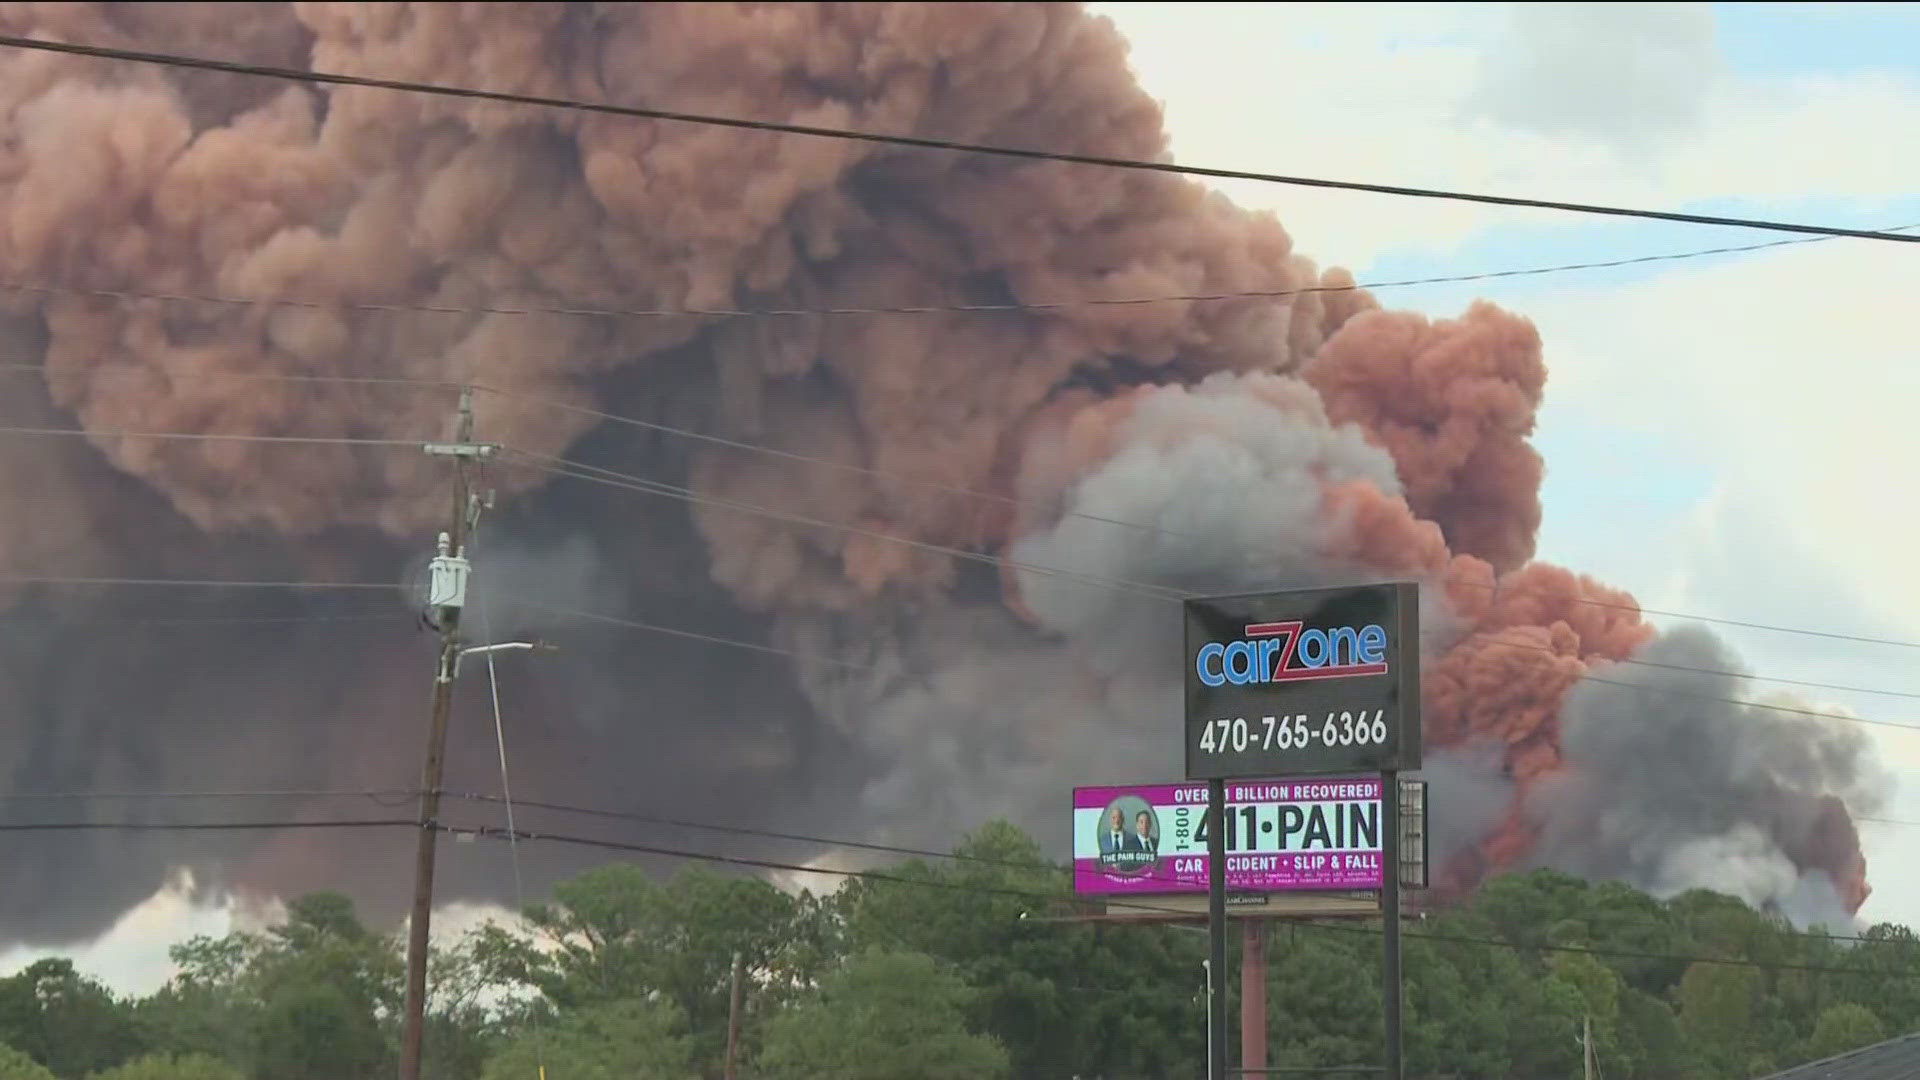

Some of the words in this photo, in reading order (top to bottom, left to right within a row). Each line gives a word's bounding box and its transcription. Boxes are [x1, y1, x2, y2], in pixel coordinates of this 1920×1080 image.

[1199, 709, 1387, 754] 470-765-6366
[1175, 789, 1209, 802] OVER
[1236, 786, 1289, 800] BILLION
[1294, 784, 1378, 798] RECOVERED!
[1103, 854, 1116, 863] THE
[1117, 852, 1134, 862] PAIN
[1135, 853, 1155, 862] GUYS
[1175, 859, 1203, 872] CAR
[1227, 857, 1277, 871] CIDENT
[1293, 855, 1325, 869] SLIP
[1331, 855, 1340, 869] &
[1345, 854, 1378, 869] FALL
